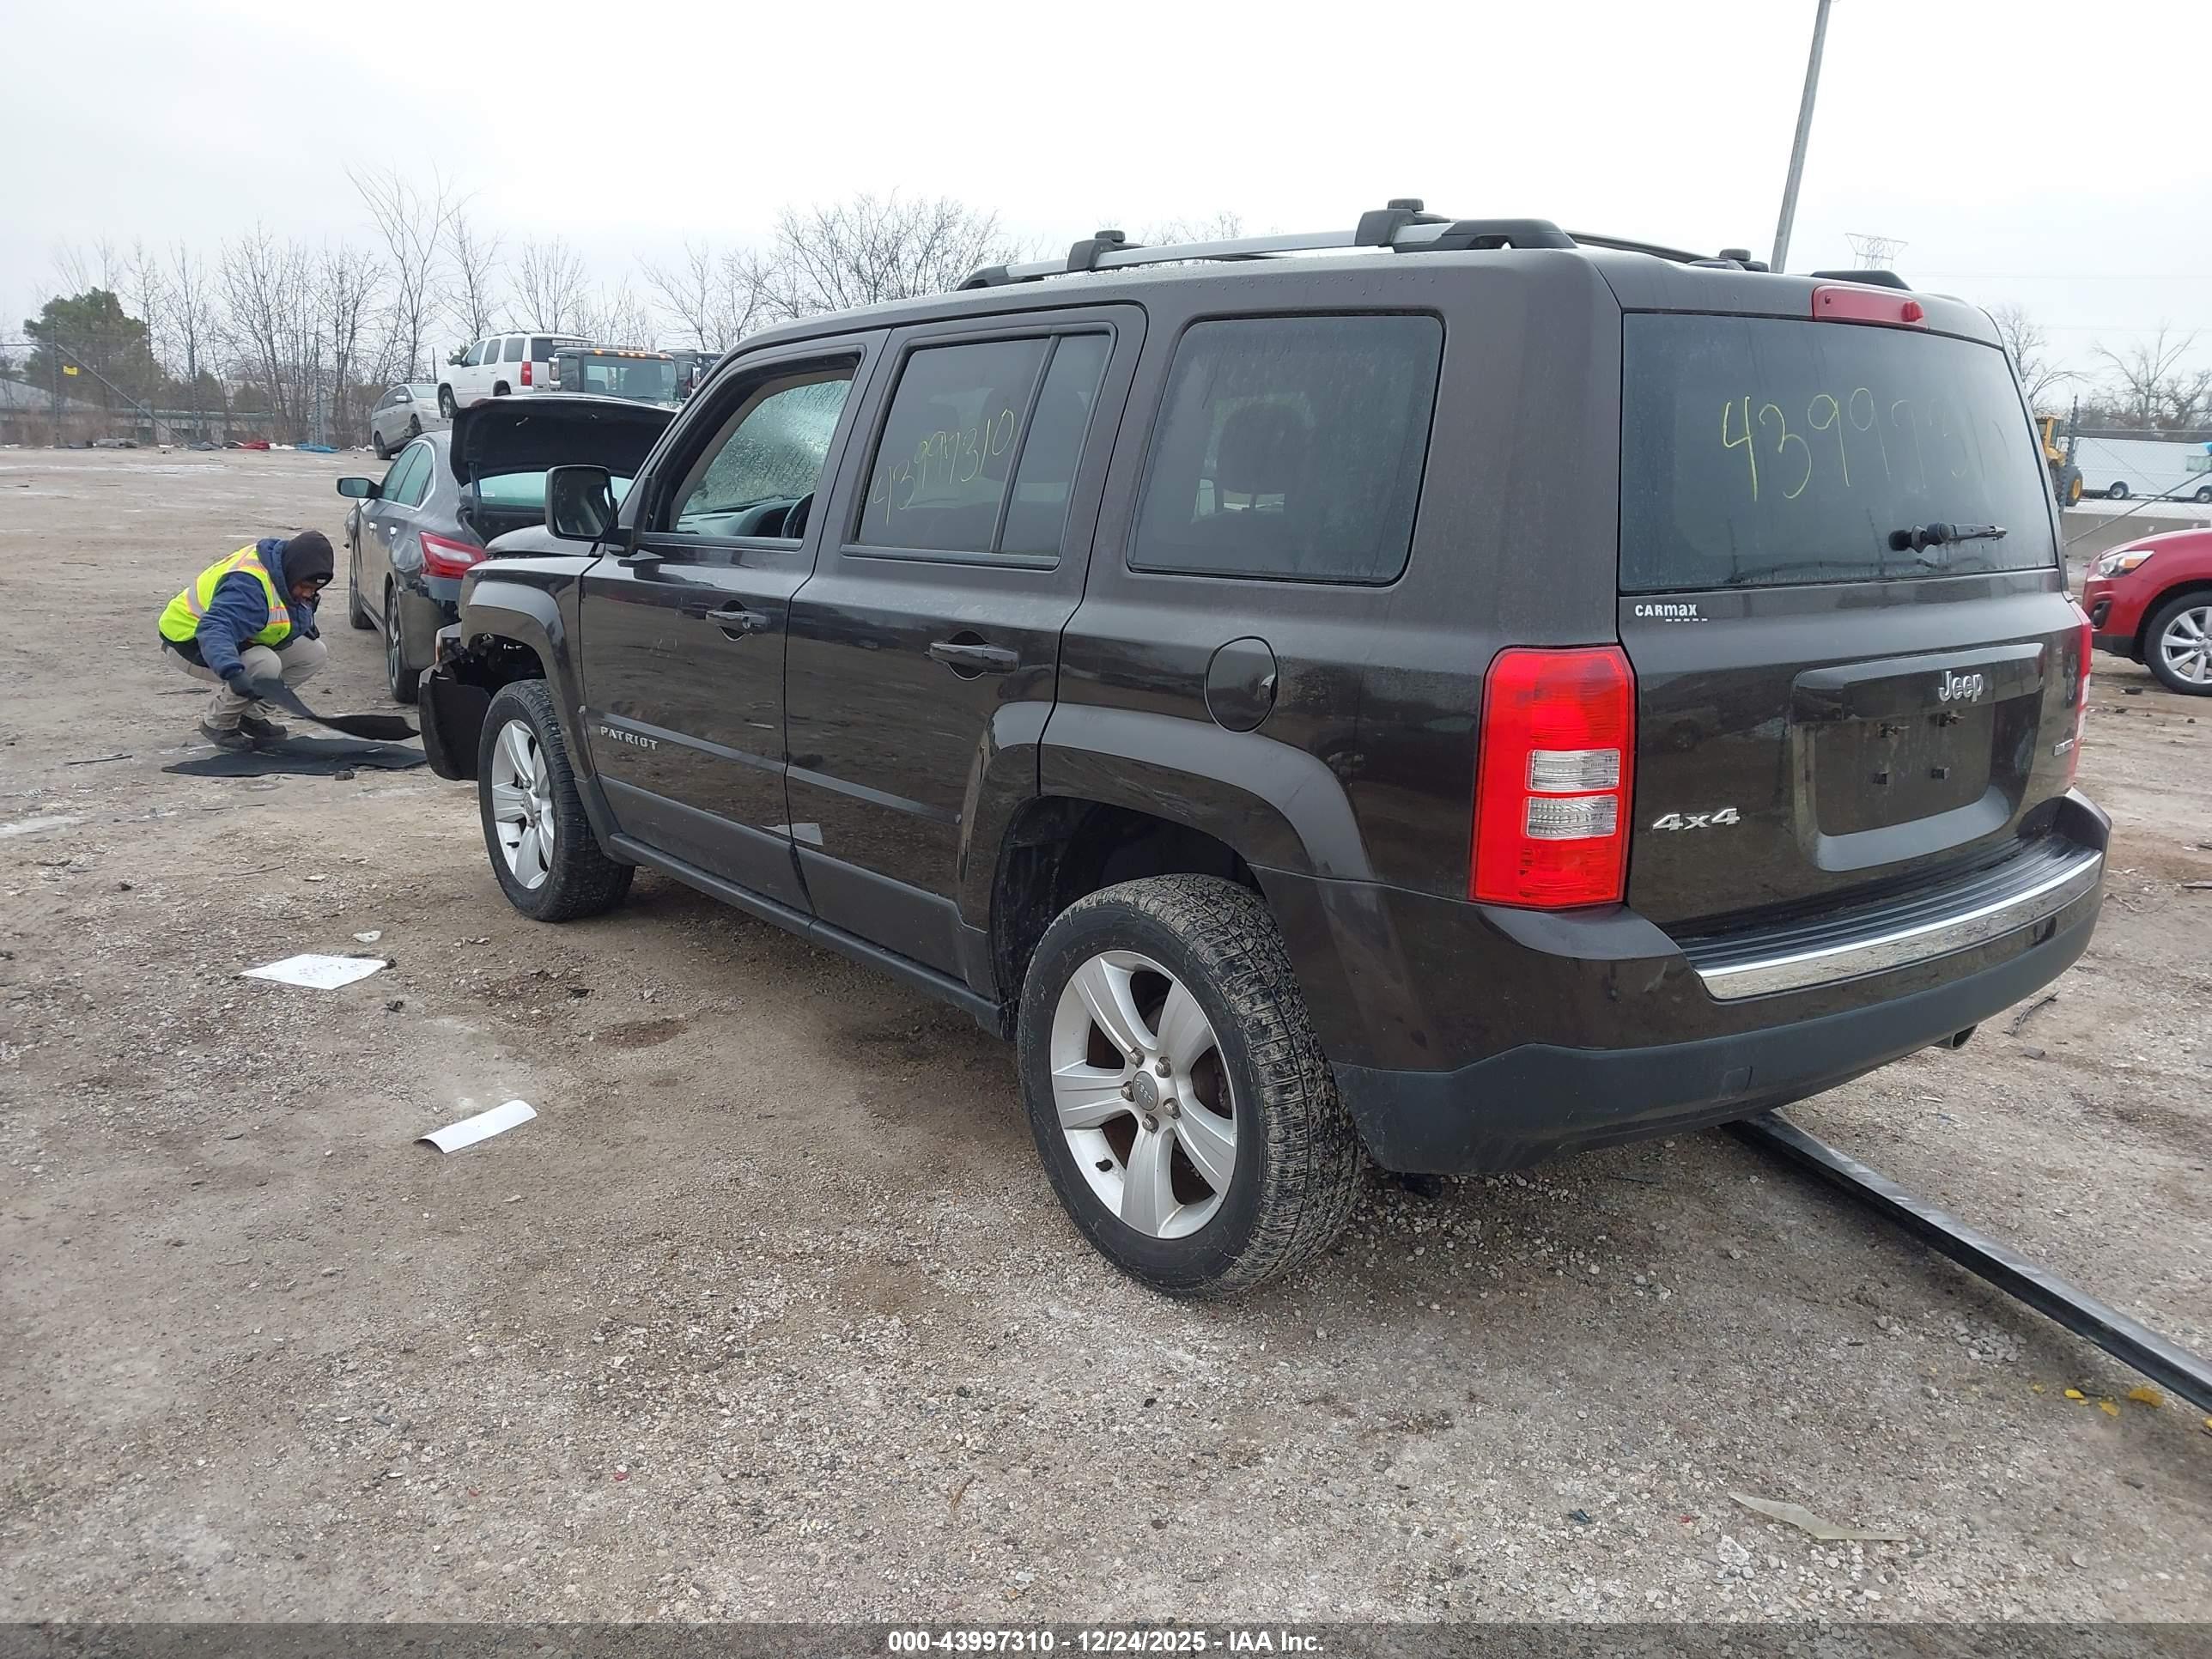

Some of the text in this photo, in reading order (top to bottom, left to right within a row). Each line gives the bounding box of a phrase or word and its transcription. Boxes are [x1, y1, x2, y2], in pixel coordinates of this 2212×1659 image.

[872, 408, 1015, 526] 43997310
[1938, 671, 1984, 702] Jeep
[599, 726, 659, 750] PATRIOT
[1652, 807, 1741, 831] 4x4
